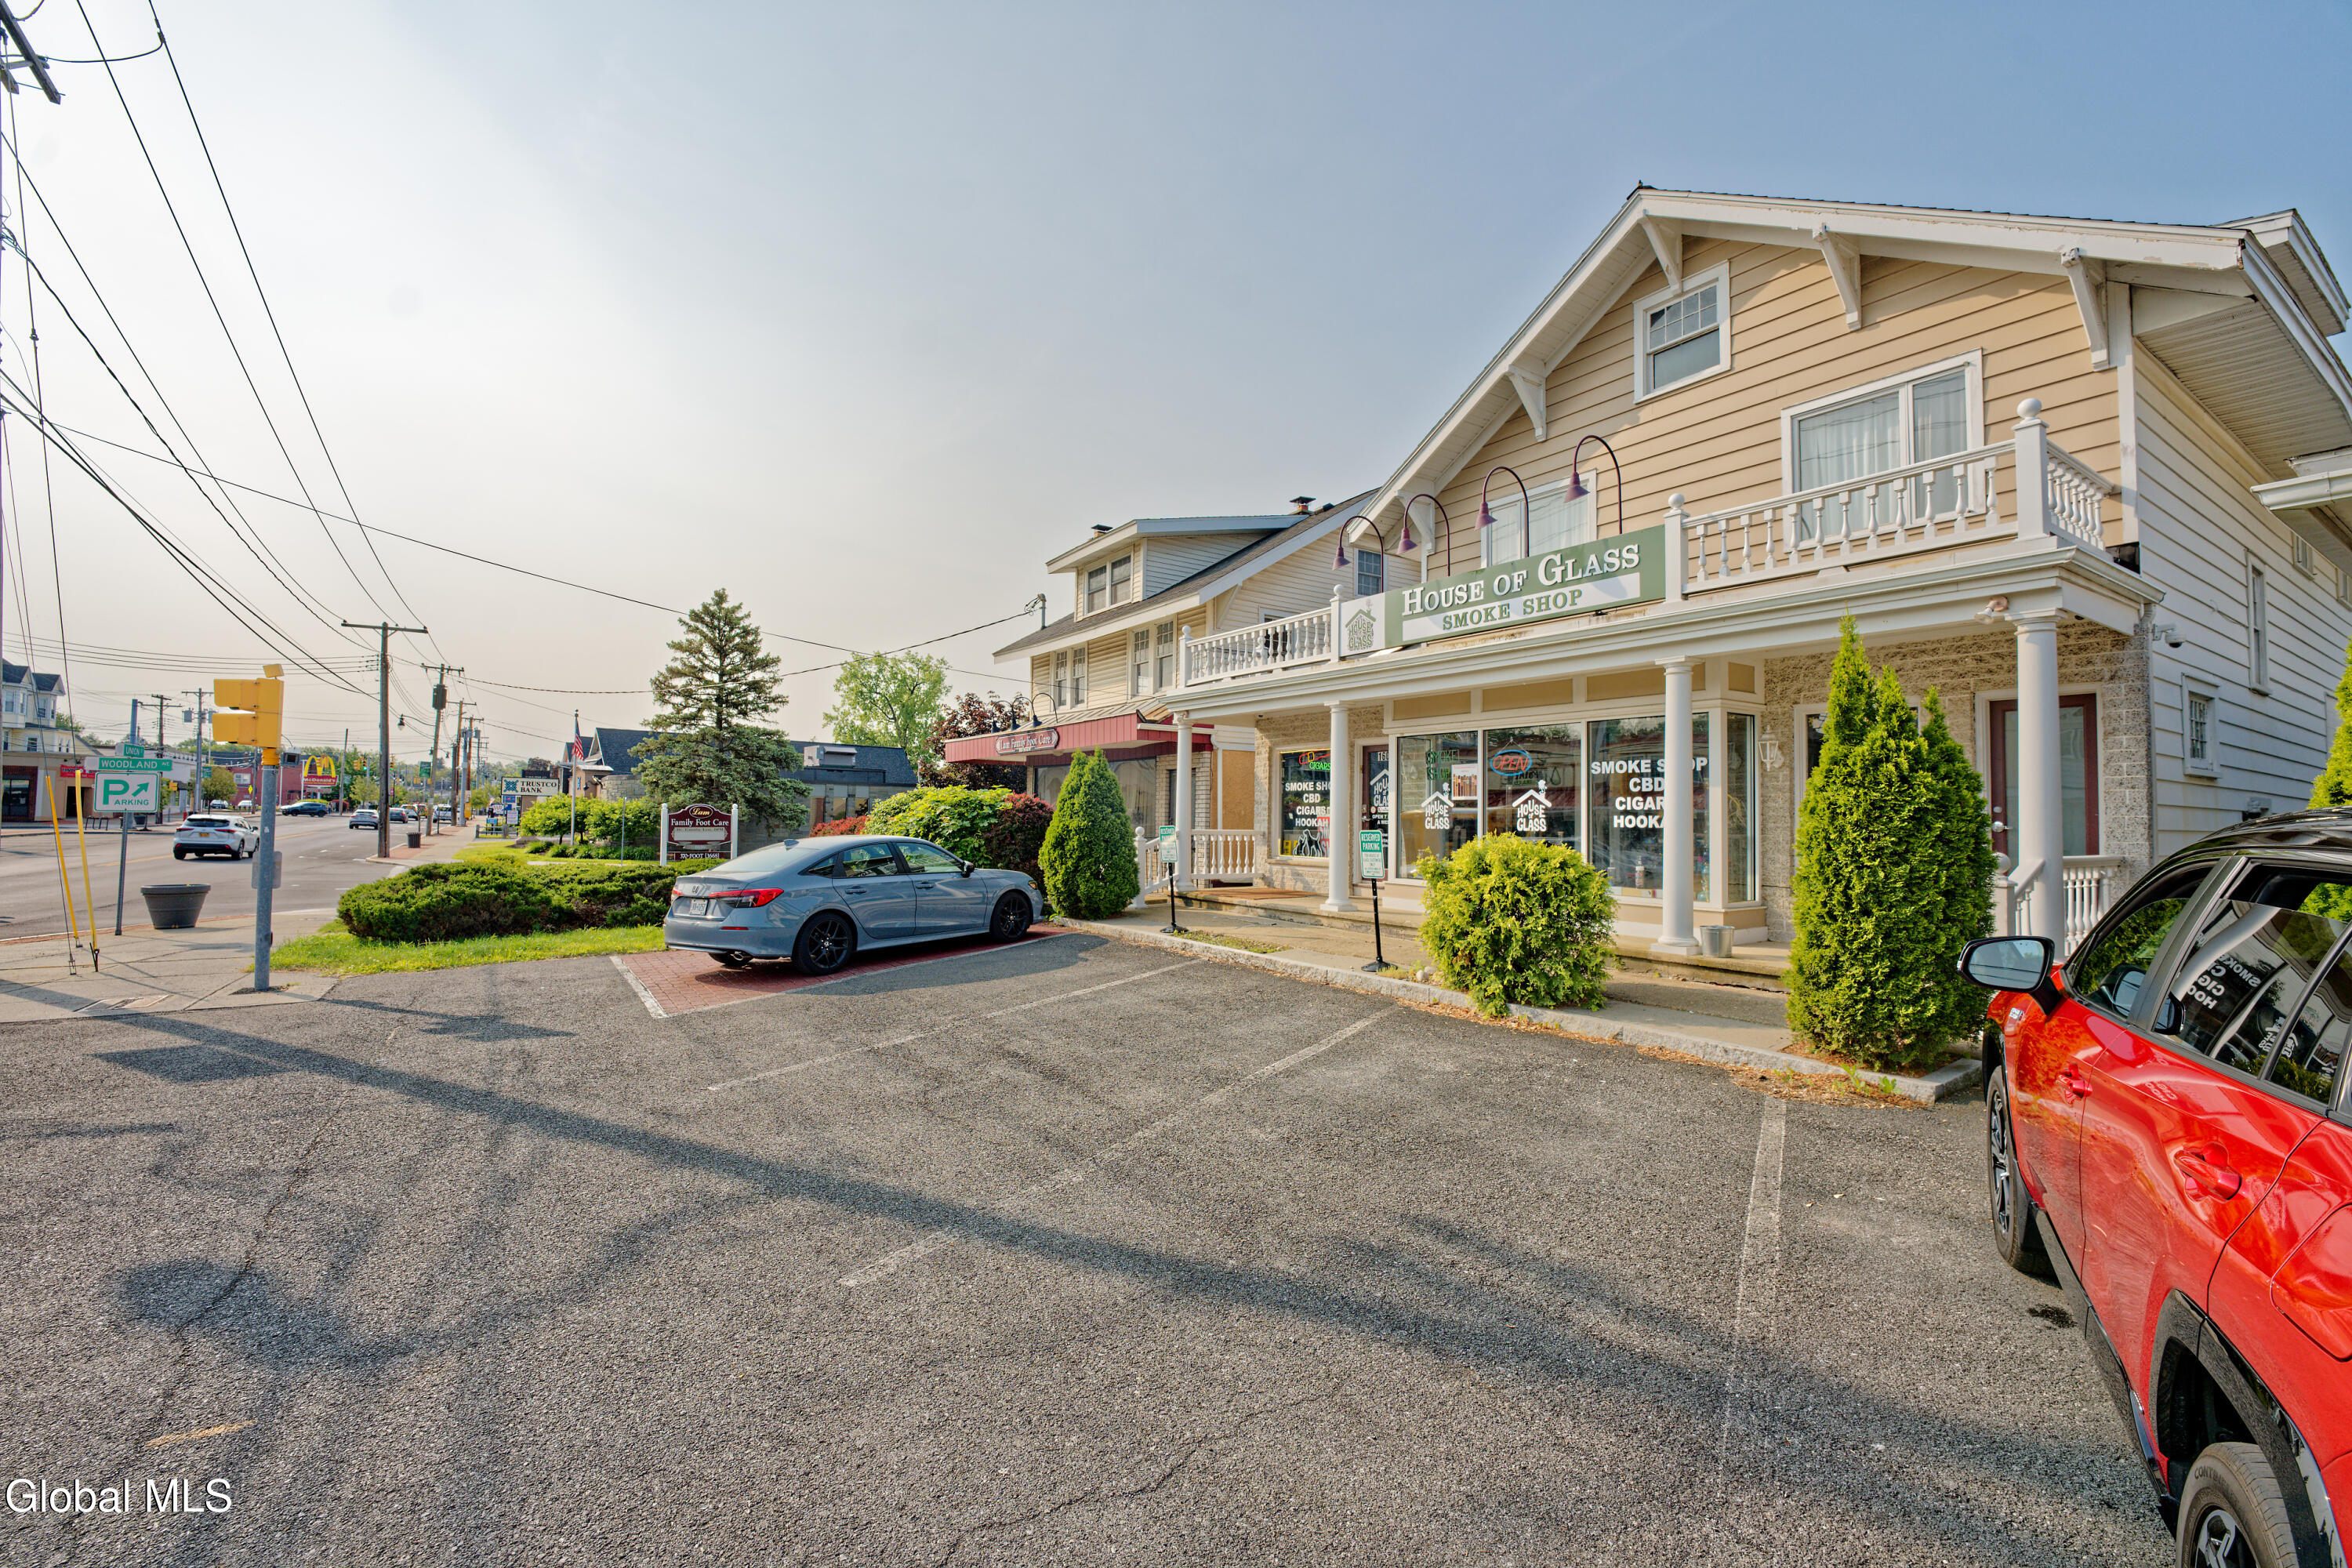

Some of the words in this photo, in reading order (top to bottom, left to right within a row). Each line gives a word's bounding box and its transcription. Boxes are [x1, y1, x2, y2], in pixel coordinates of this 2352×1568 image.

[1402, 580, 1485, 616] HOUSE
[1494, 570, 1528, 596] OF
[1537, 544, 1640, 586] GLASS
[1443, 603, 1510, 630] SMOKE
[1523, 589, 1582, 615] SHOP
[1348, 618, 1371, 637] HOUSE
[1348, 633, 1372, 649] GLASS
[1038, 735, 1051, 745] Care
[125, 746, 140, 755] UNION
[1427, 749, 1457, 764] SMOKE
[101, 759, 158, 769] WOODLAND
[1309, 761, 1330, 770] CIGARS
[1492, 755, 1529, 771] OPEN
[1591, 759, 1651, 775] SMOKE
[1285, 782, 1314, 791] SMOKE
[1629, 777, 1664, 792] CBD
[1303, 793, 1320, 804] CBD
[1615, 797, 1664, 811] CIGAR
[1296, 805, 1326, 815] CIGARS
[1425, 800, 1450, 817] HOUSE
[1517, 799, 1545, 818] HOUSE
[671, 818, 693, 828] Family
[1295, 818, 1329, 826] HOOKAH
[1425, 817, 1450, 829] GLASS
[1516, 818, 1546, 832] GLASS
